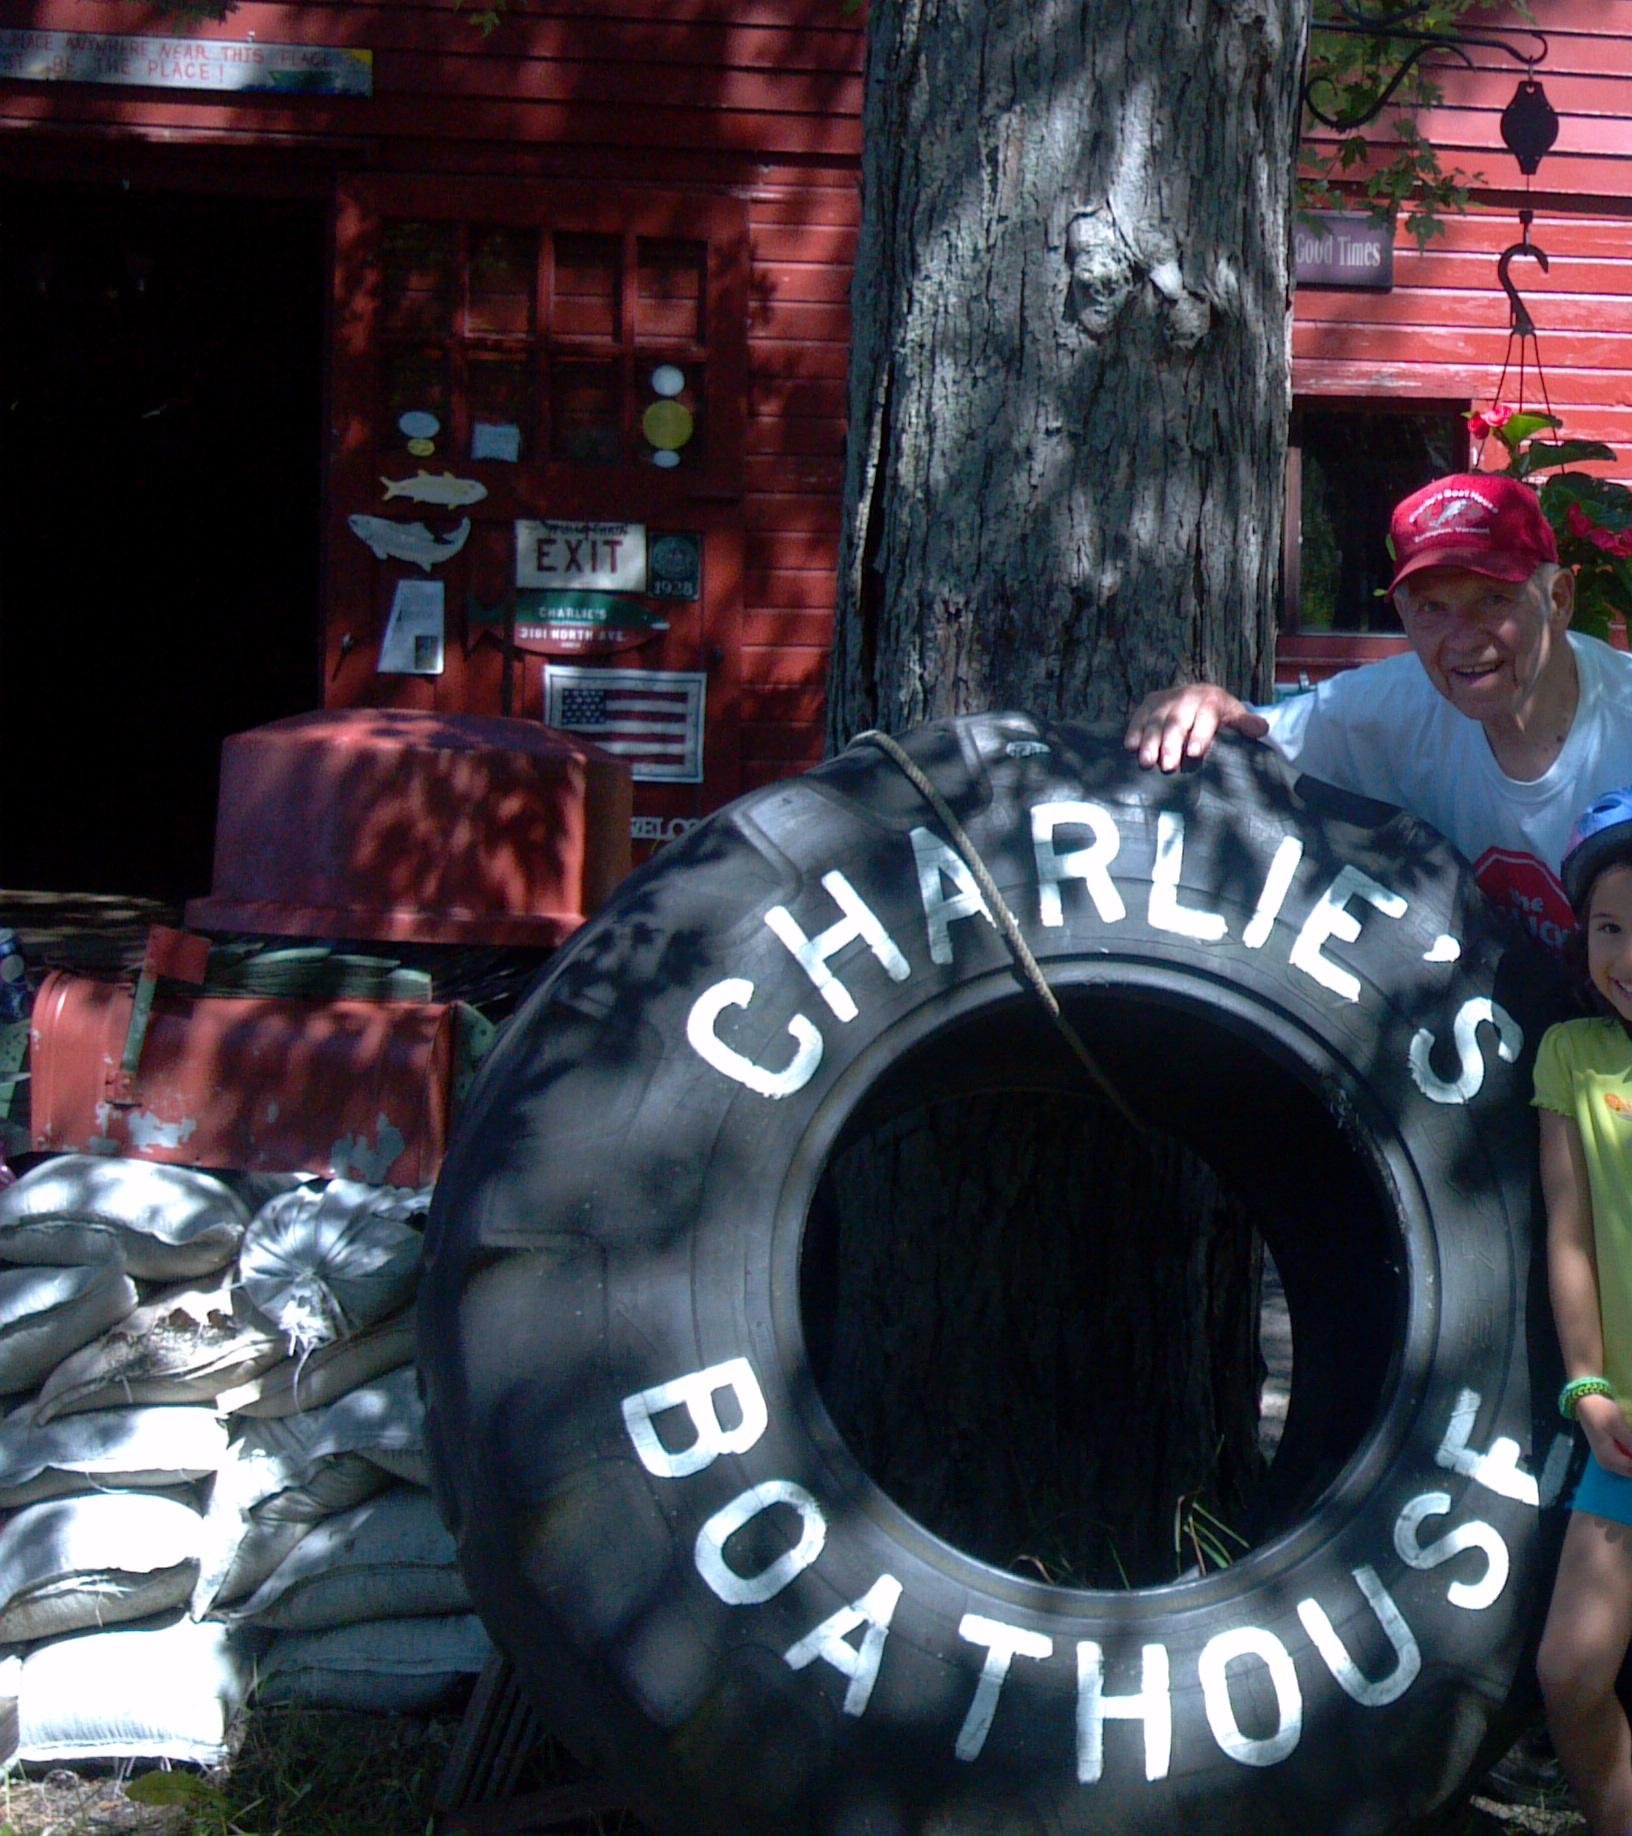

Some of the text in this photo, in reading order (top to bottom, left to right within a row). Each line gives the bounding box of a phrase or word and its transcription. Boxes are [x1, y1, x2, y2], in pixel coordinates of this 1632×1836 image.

[159, 43, 208, 60] NEAR
[221, 46, 265, 64] THIS
[1295, 233, 1381, 267] Good Times
[537, 538, 623, 573] EXIT
[551, 628, 593, 641] NORTH
[687, 801, 1522, 1106] CHARLIE'S
[621, 1357, 1574, 1783] BOATHOUSE
